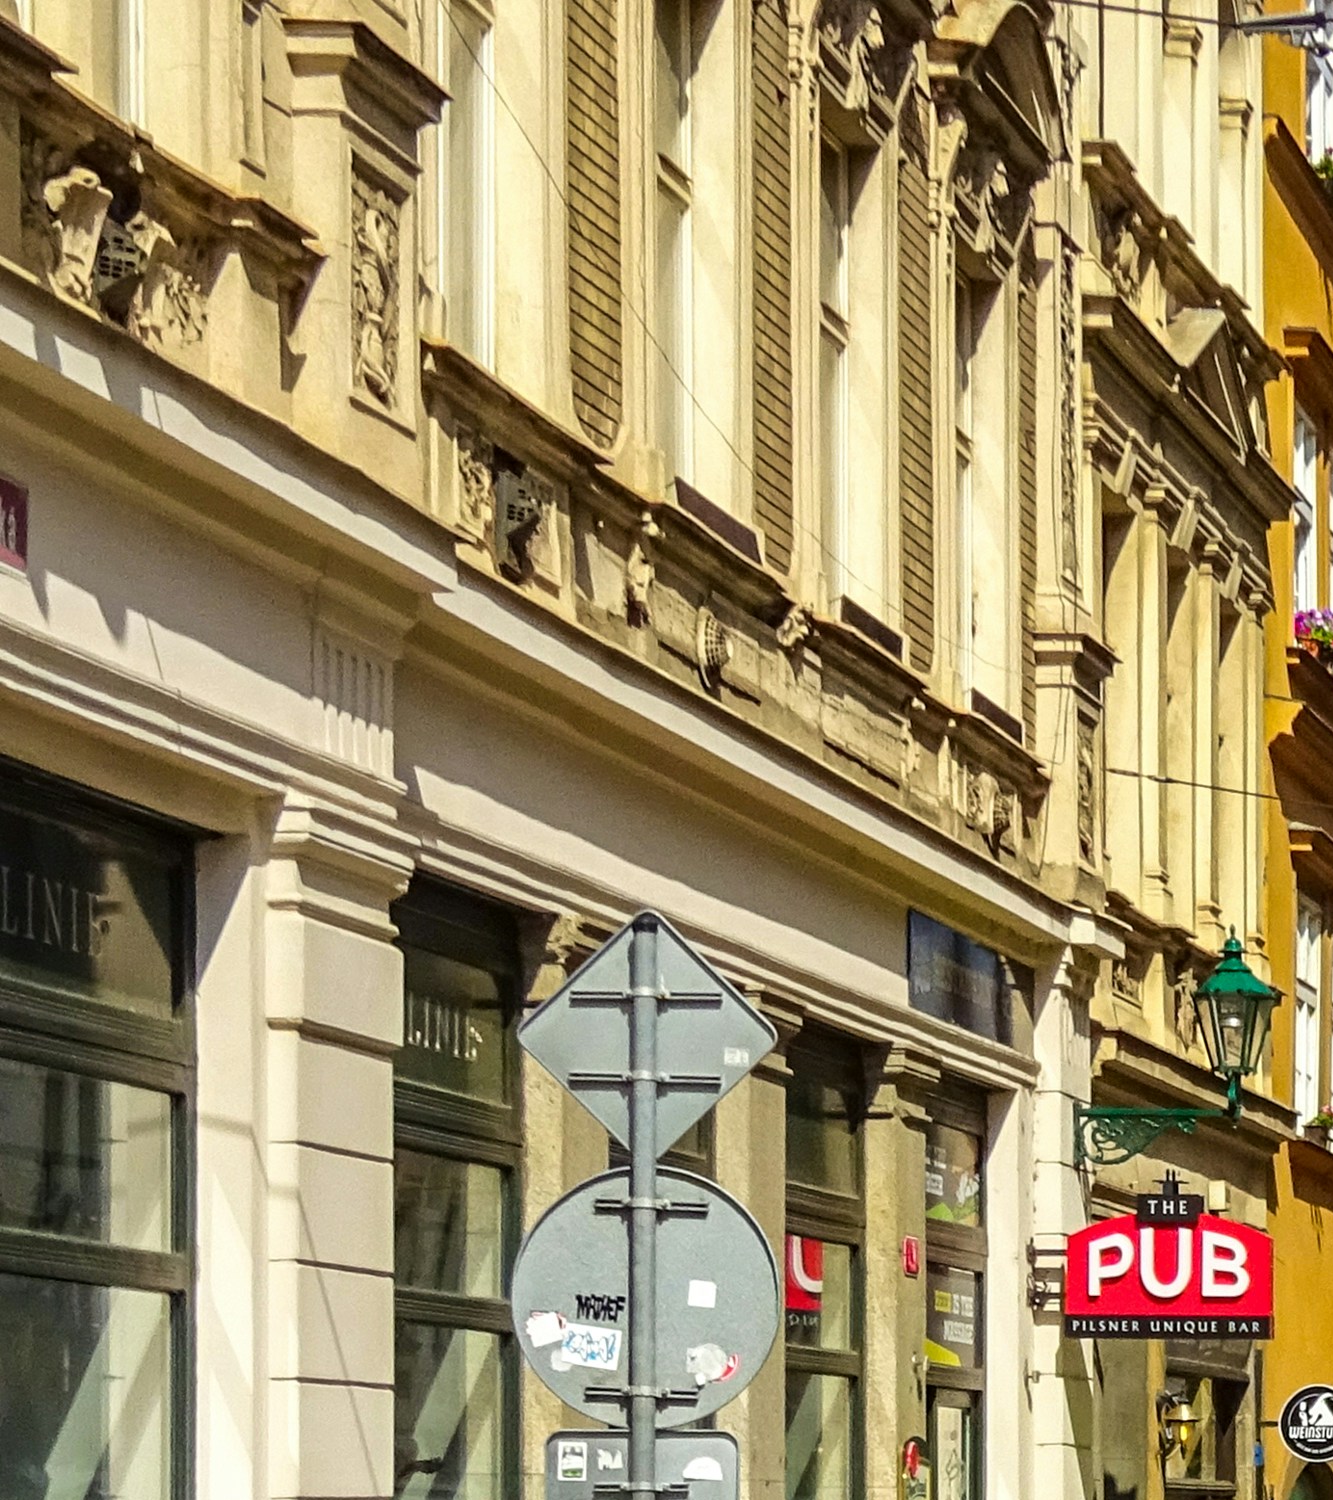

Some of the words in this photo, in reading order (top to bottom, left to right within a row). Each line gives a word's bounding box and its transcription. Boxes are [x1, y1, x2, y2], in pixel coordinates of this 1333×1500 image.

[1147, 1200, 1188, 1215] THE
[1088, 1226, 1250, 1299] PUB
[1072, 1320, 1140, 1332] PILSNER
[1149, 1320, 1218, 1334] UNIQUE
[1228, 1320, 1260, 1333] BAR
